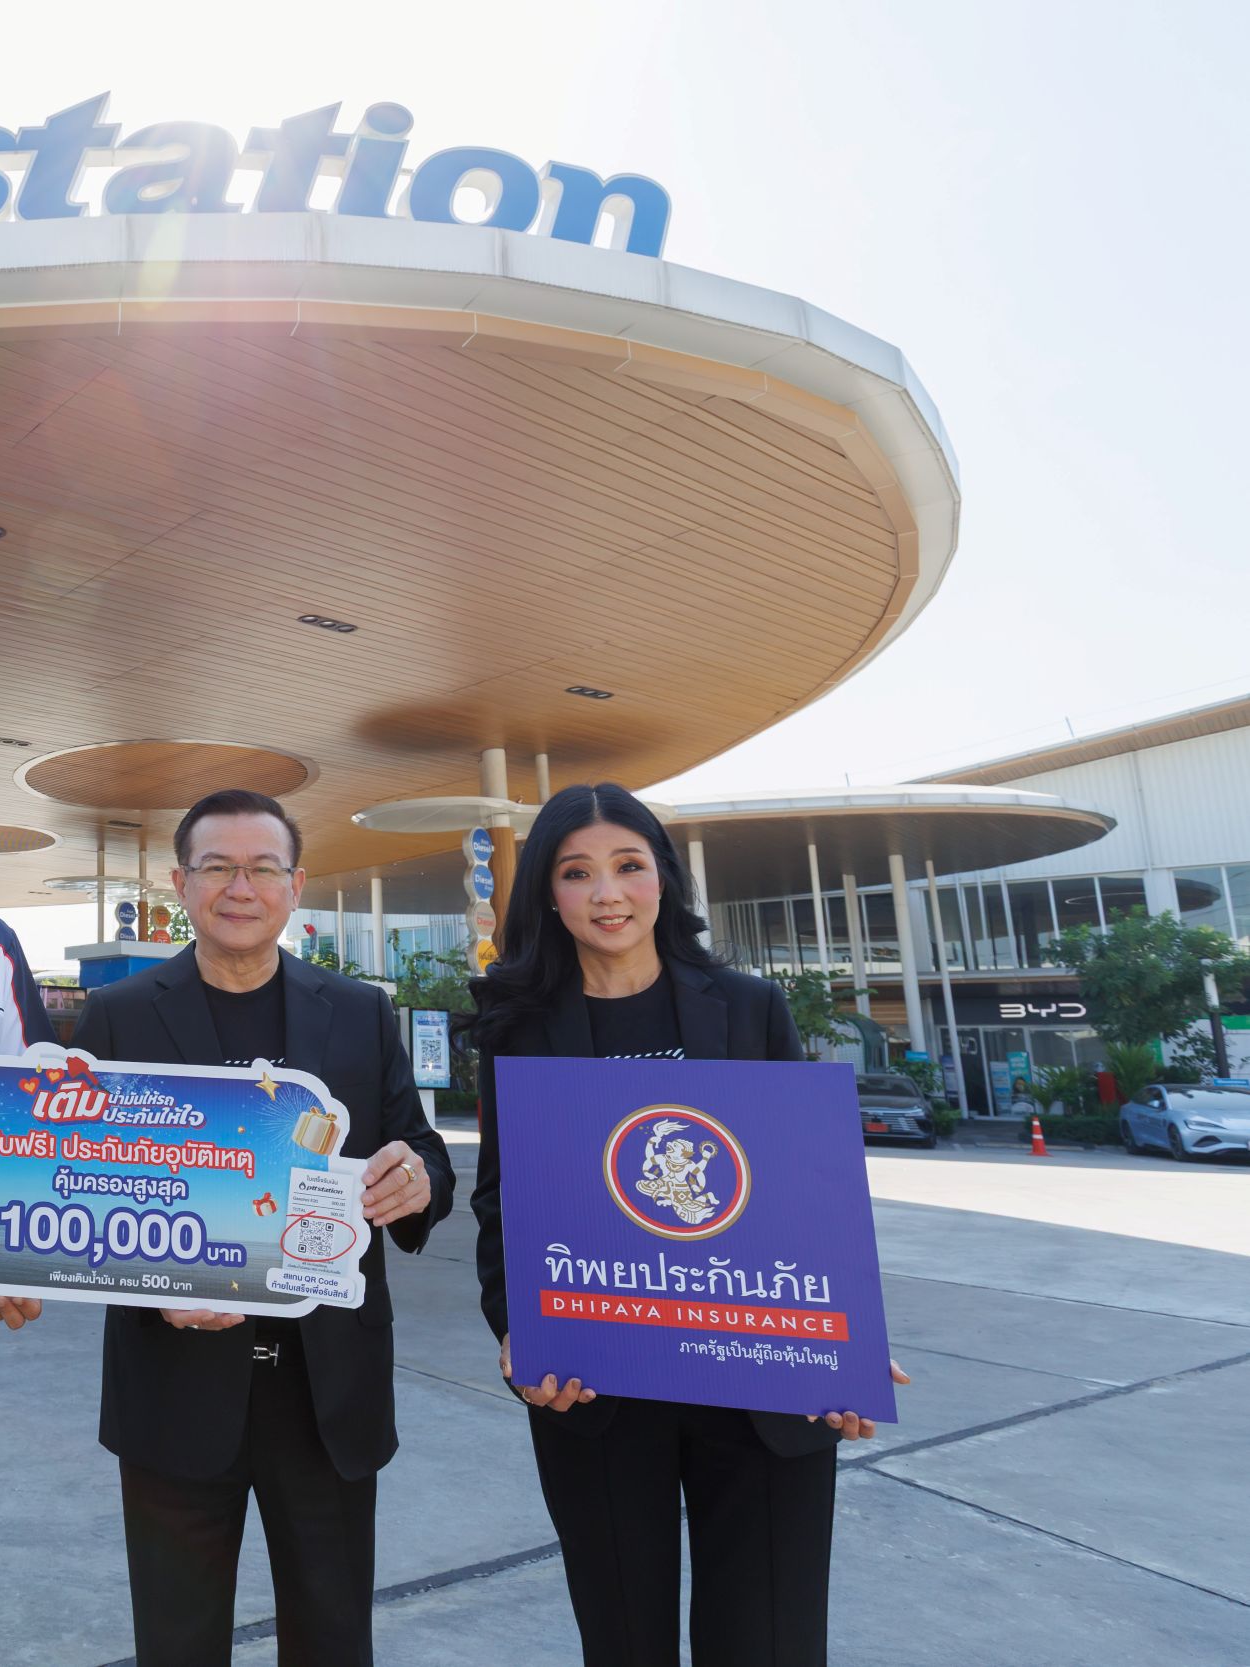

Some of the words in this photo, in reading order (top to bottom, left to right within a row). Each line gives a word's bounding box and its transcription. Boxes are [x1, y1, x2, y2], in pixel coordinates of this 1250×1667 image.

[999, 1002, 1087, 1018] BYD
[32, 1082, 106, 1119] เติม
[102, 1104, 205, 1127] ประกันให้ใจ
[63, 1134, 254, 1177] ประกันภัยอุบัติเหตุ
[54, 1168, 187, 1203] คุ้มครองสูงสุด
[0, 1204, 203, 1263] 100,000
[207, 1246, 242, 1263] บาท
[119, 1278, 139, 1287] ครบ
[141, 1274, 170, 1290] 500
[173, 1281, 192, 1291] บาท
[283, 1272, 303, 1282] สแกน
[304, 1275, 317, 1284] QR
[318, 1277, 339, 1287] Code
[545, 1243, 831, 1304] ทิพยประกันภัย
[553, 1297, 661, 1319] DHIPAYA
[677, 1307, 834, 1333] INSURANCE
[679, 1339, 839, 1371] ภาครัฐเป็นผู้ถือหุ้นใหญ่
